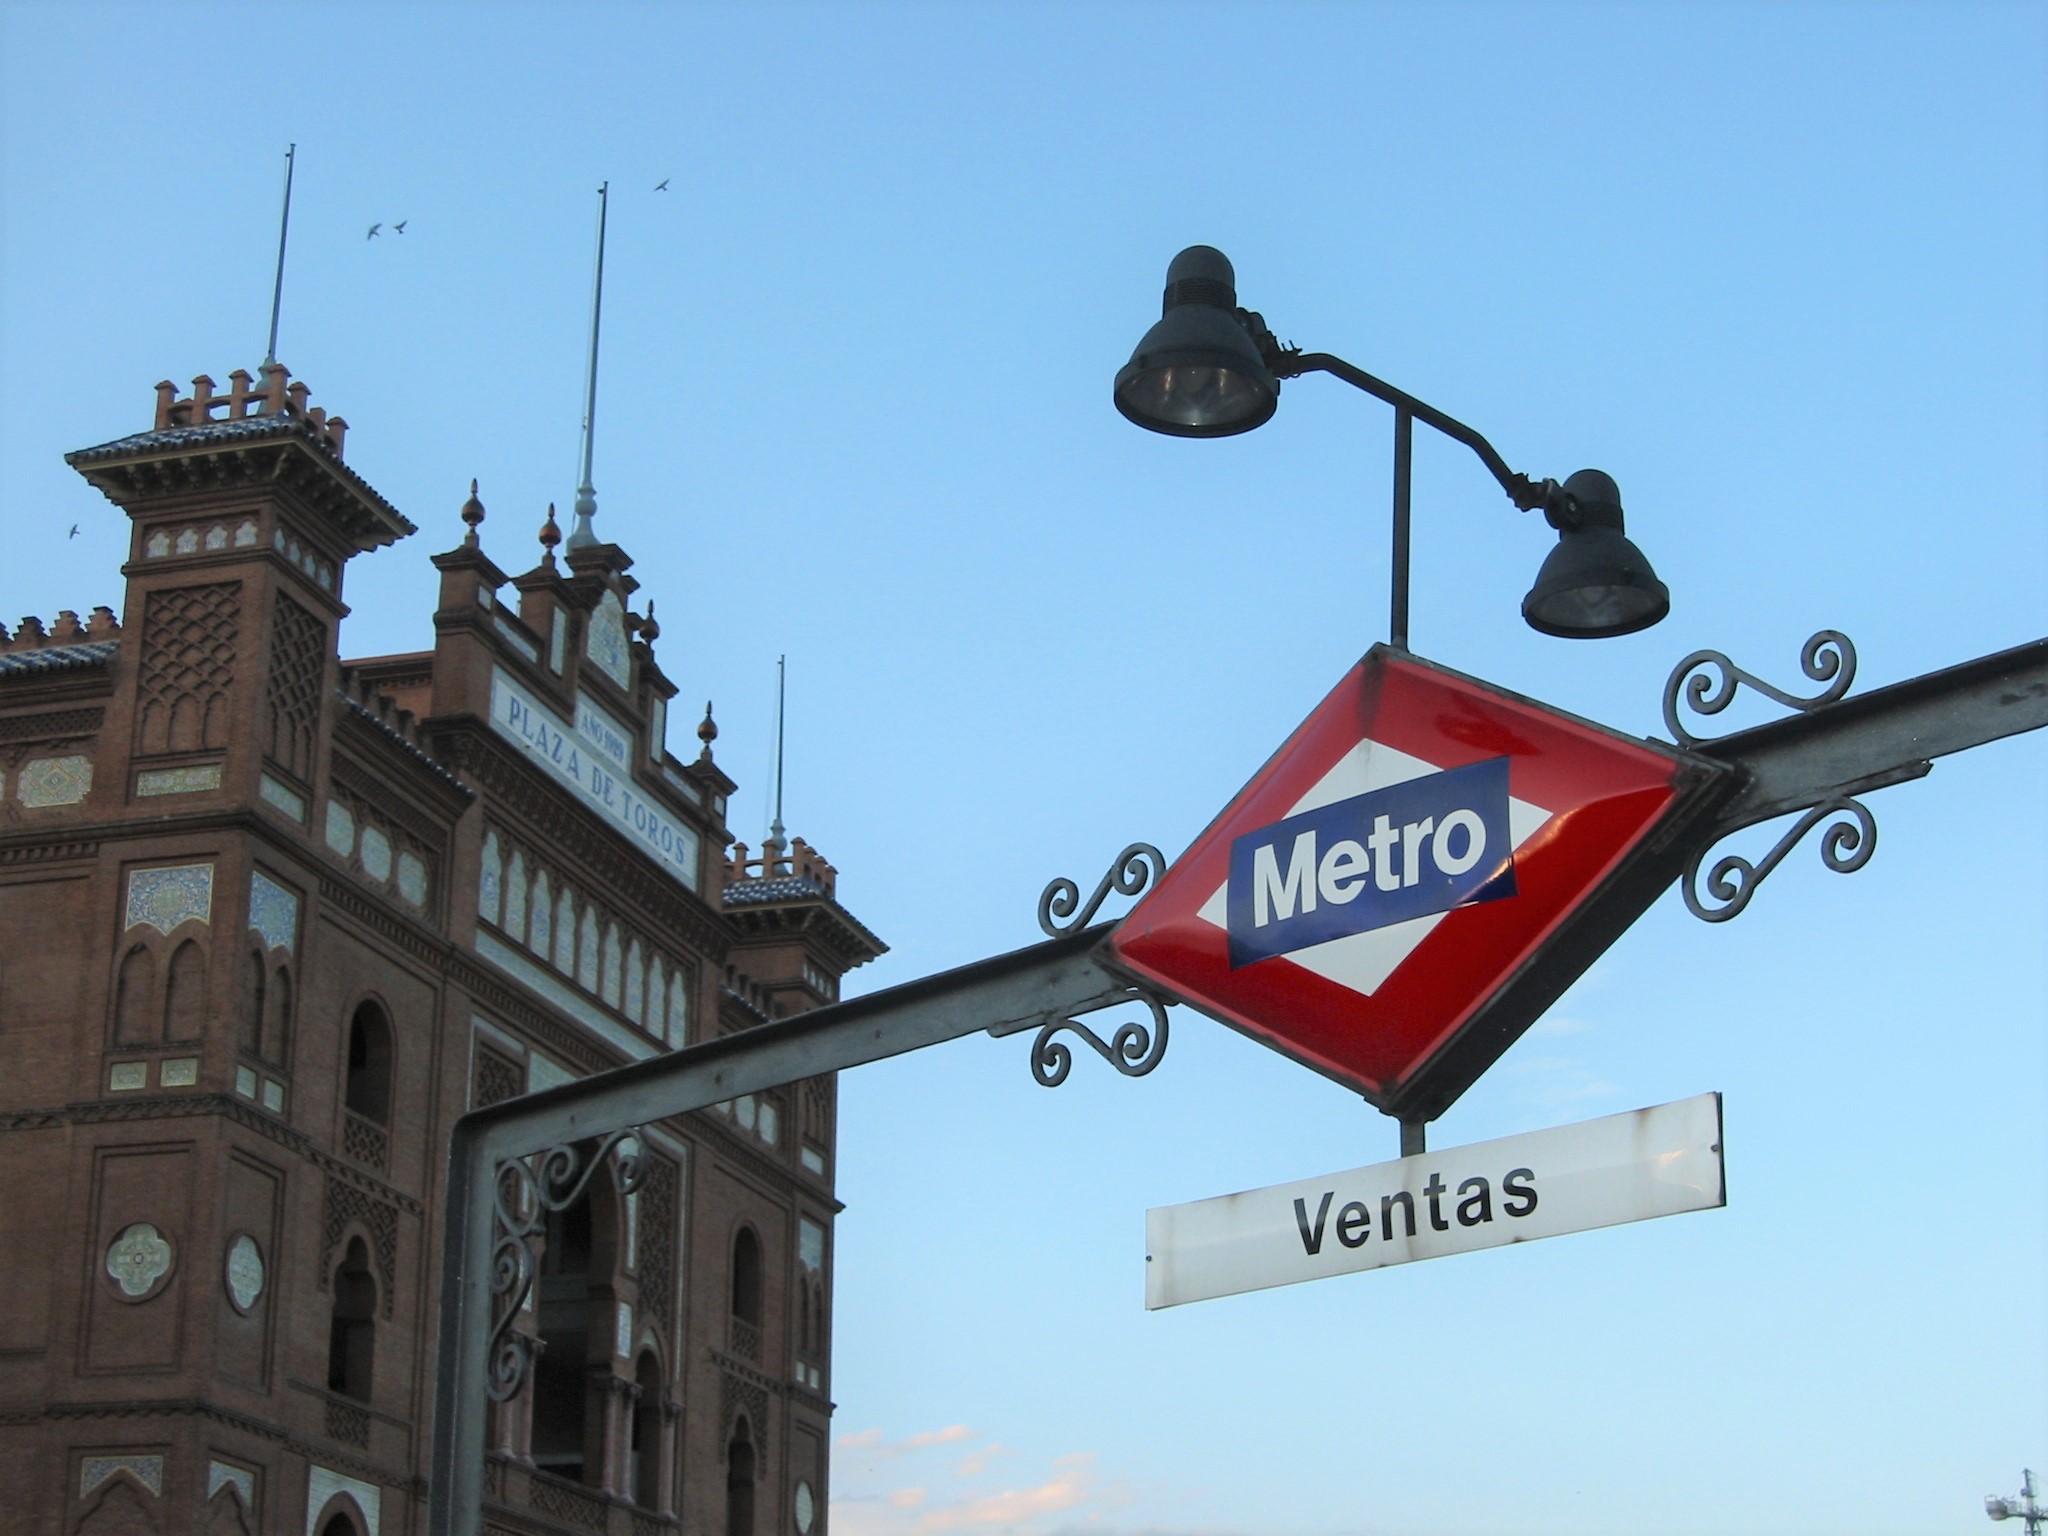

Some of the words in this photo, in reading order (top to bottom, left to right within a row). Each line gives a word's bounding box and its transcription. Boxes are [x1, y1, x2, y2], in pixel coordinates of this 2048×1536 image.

[509, 695, 580, 780] PLAZA
[592, 765, 614, 807] DE
[623, 790, 685, 865] TOROS
[1253, 808, 1487, 928] Metro
[1293, 1167, 1539, 1256] Ventas
